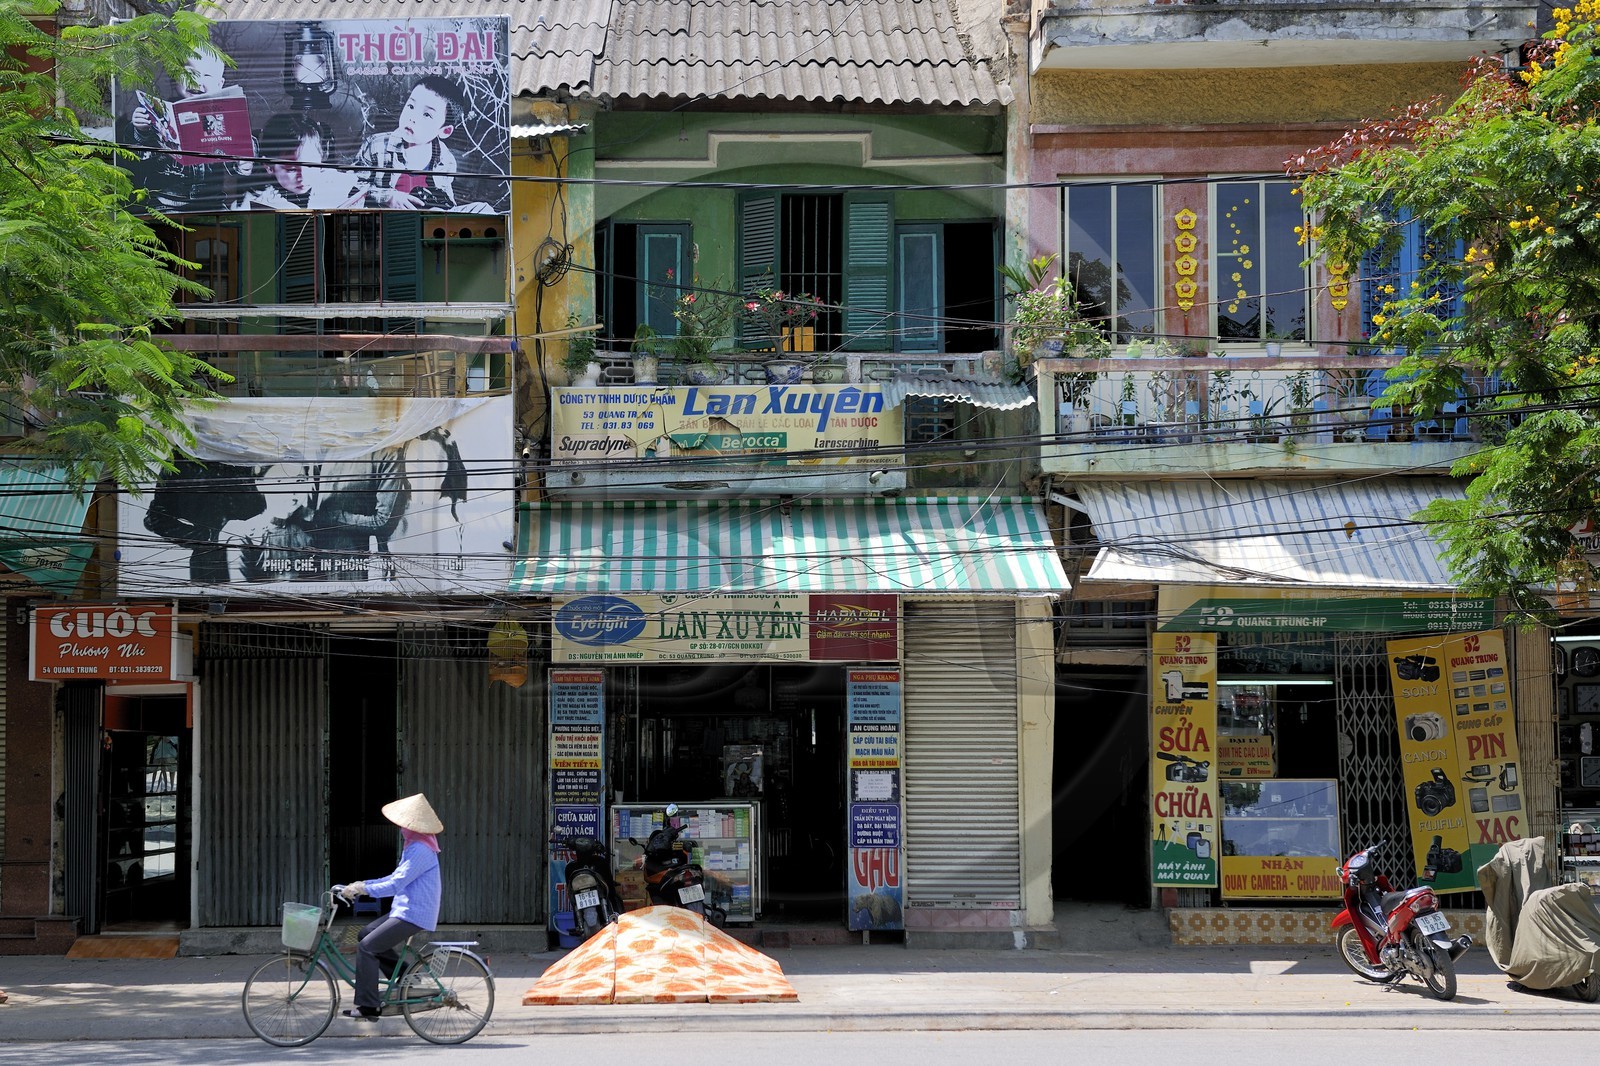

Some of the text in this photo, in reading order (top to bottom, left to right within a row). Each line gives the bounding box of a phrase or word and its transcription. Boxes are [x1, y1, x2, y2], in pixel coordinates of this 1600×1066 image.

[391, 66, 443, 75] QUANG
[560, 392, 583, 404] CÔNG
[585, 394, 596, 404] TY
[598, 394, 621, 404] TNHH
[598, 411, 625, 419] QUANG
[682, 386, 884, 433] Lan Xuyên
[581, 422, 595, 430] TEL
[559, 436, 631, 455] Supradyne
[721, 435, 780, 449] Berocca
[320, 560, 333, 572] IN
[571, 613, 629, 632] Eyelight
[659, 601, 803, 640] LAN XUYÊN
[1198, 606, 1234, 626] 52
[1237, 617, 1328, 627] QUANG TRUNG-HP
[117, 643, 146, 658] Nhi
[1175, 635, 1191, 653] 52
[1464, 635, 1481, 653] 52
[1159, 656, 1208, 666] QUANG TRUNG
[1450, 653, 1499, 669] QUANG TRUNG
[1401, 685, 1439, 699] SONY
[1155, 703, 1193, 716] CHUYÊN
[1456, 719, 1482, 731] CUNG
[1159, 716, 1210, 753] SỬA
[1466, 732, 1507, 760] PIN
[1403, 750, 1448, 764] CANON
[1154, 785, 1214, 818] CHỮA
[574, 825, 595, 836] NÁCH
[1418, 817, 1464, 832] FUJIFILM
[1157, 861, 1206, 871] MÁY ẢNH
[1261, 858, 1304, 871] NHẬN
[1157, 870, 1211, 881] MÁY QUAY
[1225, 875, 1248, 890] QUAY
[1251, 875, 1288, 890] CAMERA
[1297, 874, 1320, 893] CHỤP
[1424, 921, 1446, 932] 7829
